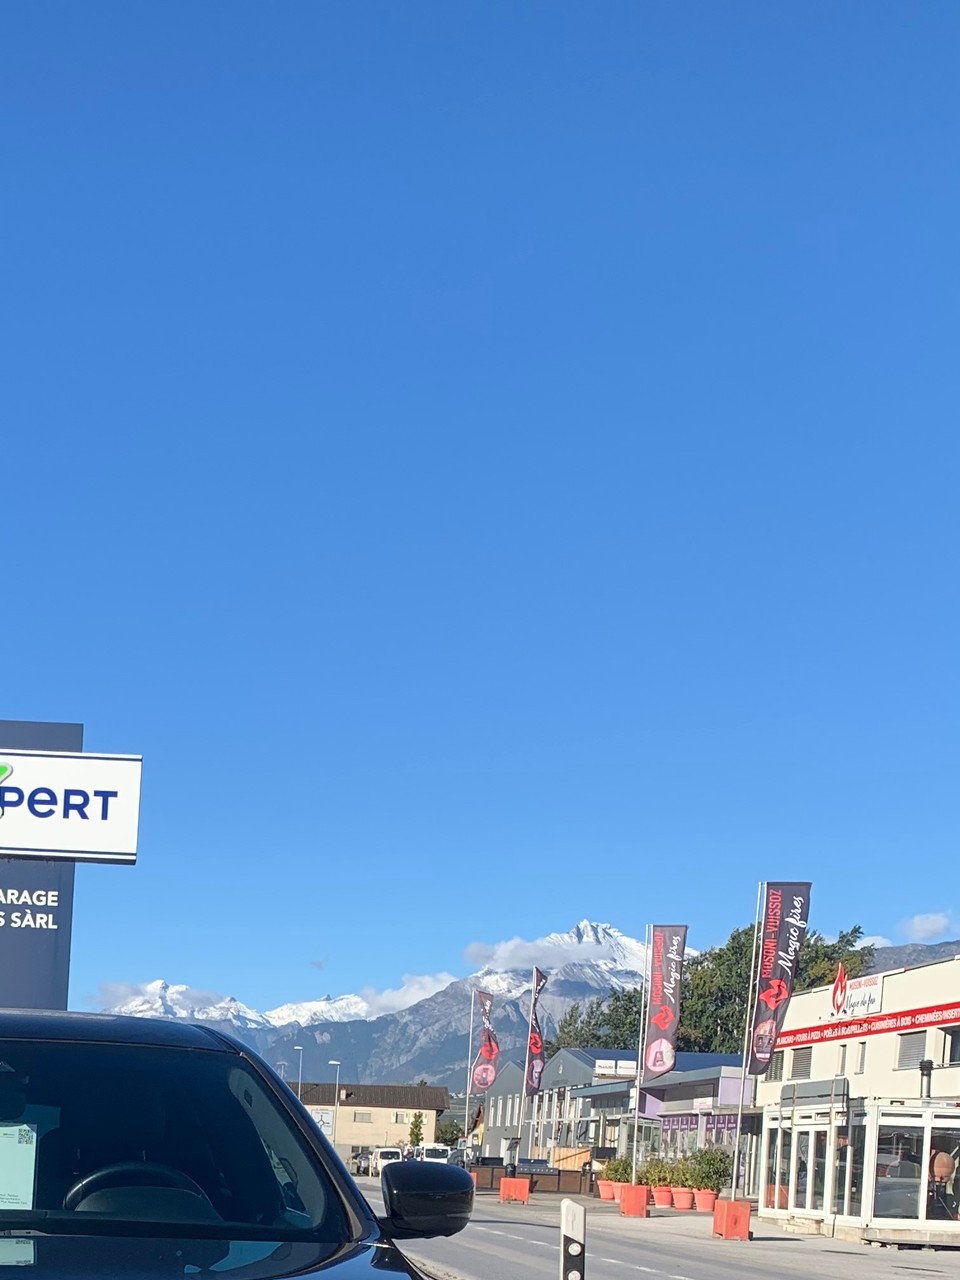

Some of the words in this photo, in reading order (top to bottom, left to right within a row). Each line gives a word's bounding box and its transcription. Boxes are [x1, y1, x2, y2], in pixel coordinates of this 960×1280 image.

[10, 908, 58, 929] SÀRL
[785, 895, 808, 928] fires
[667, 935, 682, 961] fires
[777, 925, 800, 975] Magic
[663, 961, 680, 1004] Magic
[901, 1017, 911, 1028] BOIS
